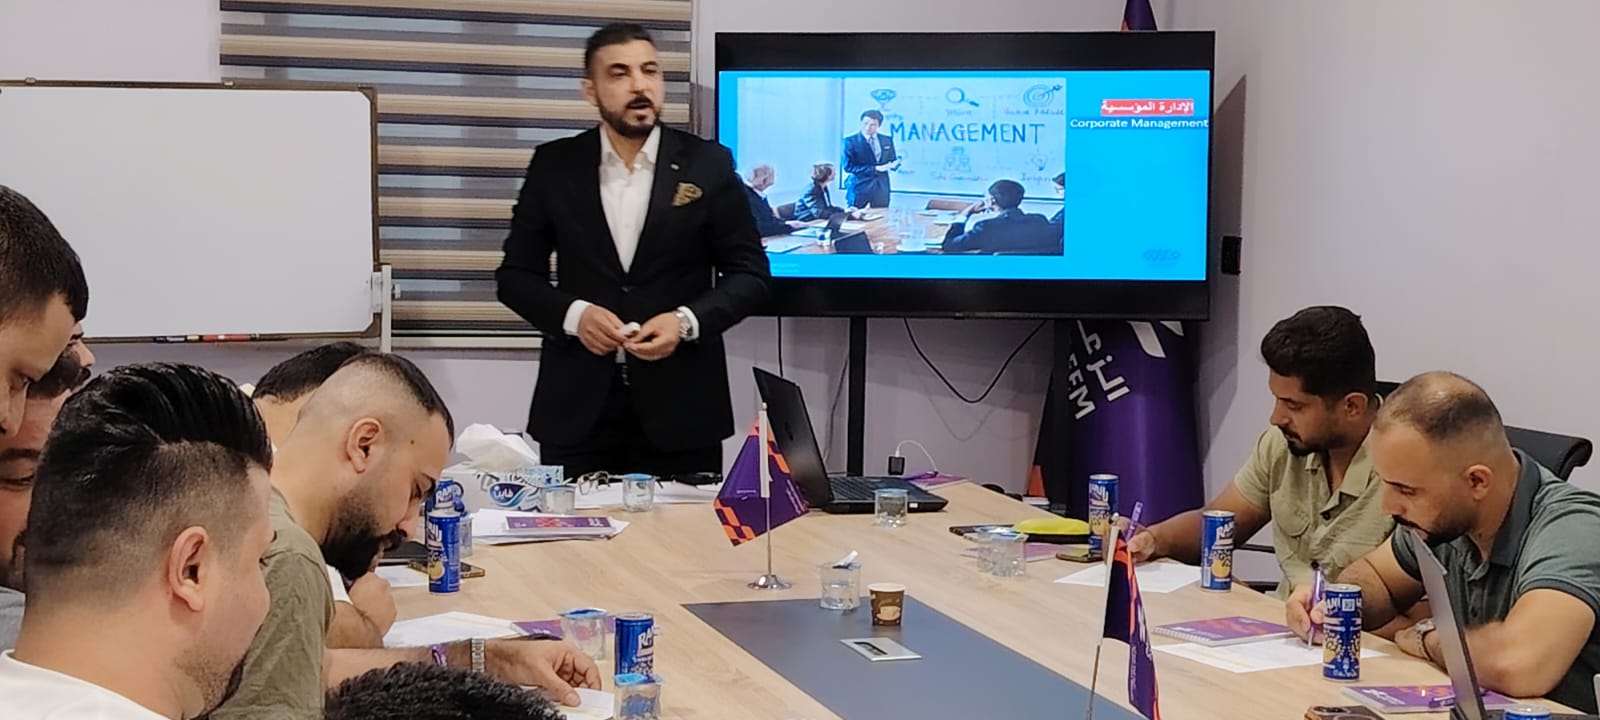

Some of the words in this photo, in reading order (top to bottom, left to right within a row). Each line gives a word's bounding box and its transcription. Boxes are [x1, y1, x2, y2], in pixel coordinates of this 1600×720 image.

[1070, 118, 1129, 129] Corporate
[1131, 118, 1209, 129] Management
[891, 122, 1045, 144] MANAGEMENT
